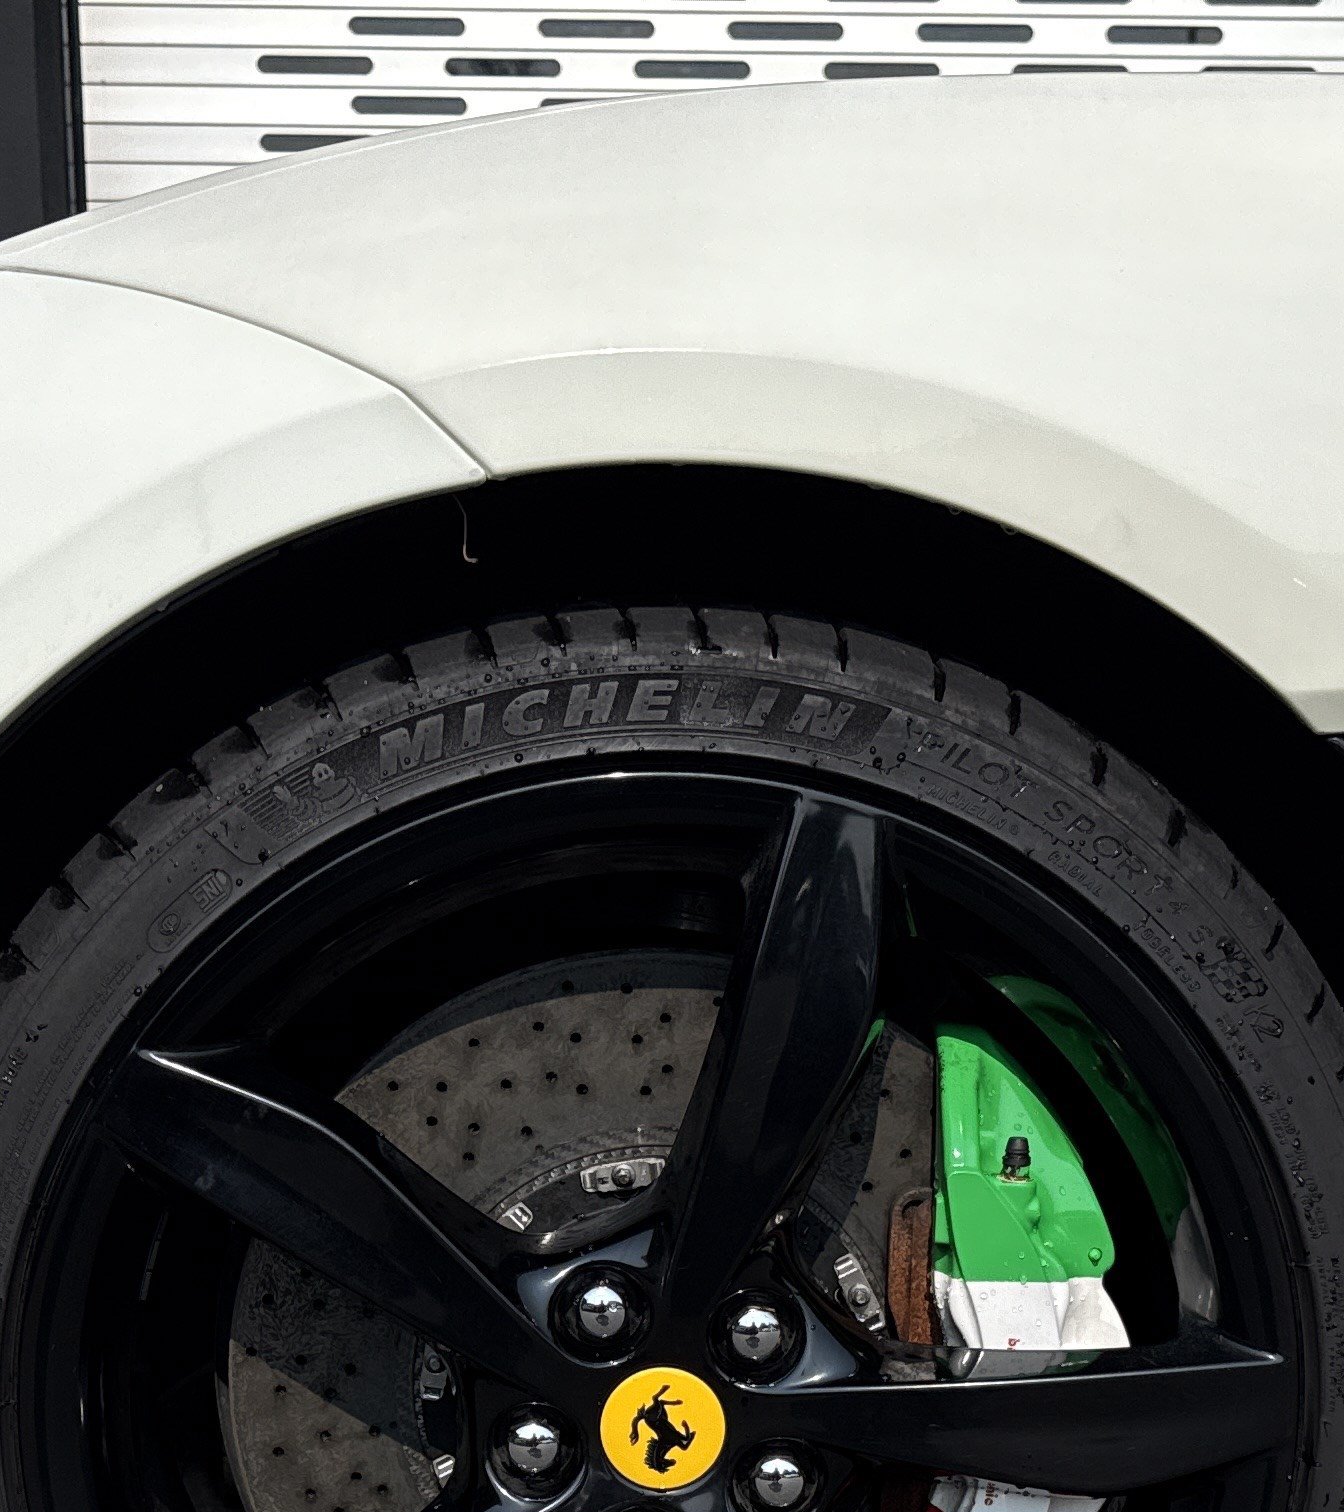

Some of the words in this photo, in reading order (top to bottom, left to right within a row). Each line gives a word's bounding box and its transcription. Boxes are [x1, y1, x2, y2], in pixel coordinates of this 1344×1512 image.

[378, 678, 858, 780] MICHELIN
[917, 729, 1040, 800] PILOT
[1044, 797, 1173, 898] SPORT
